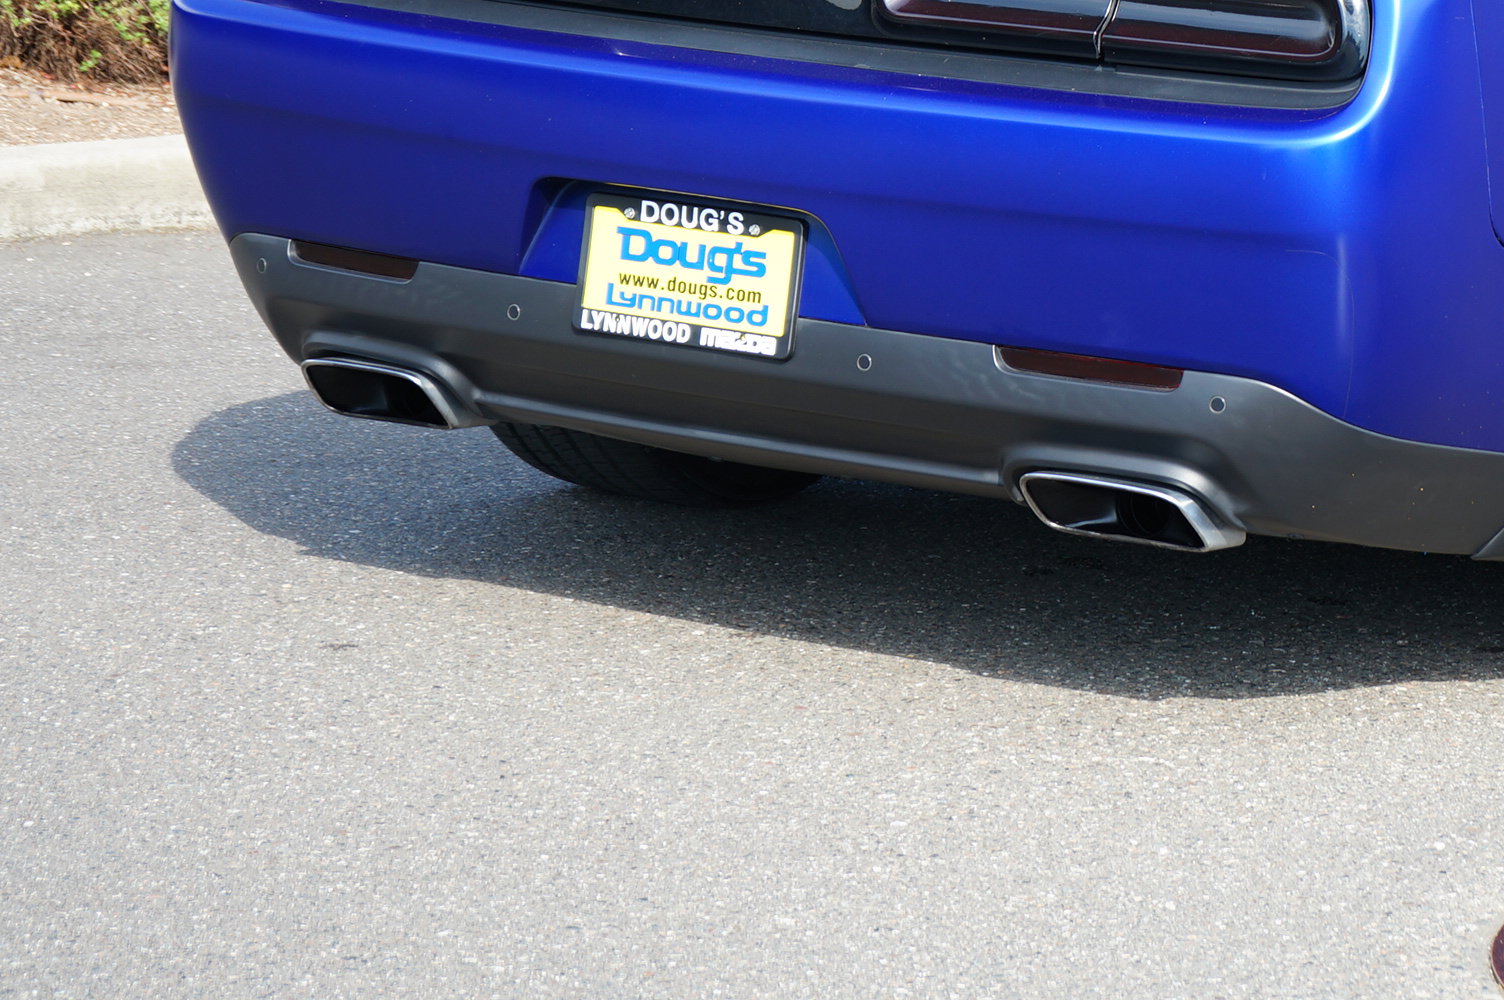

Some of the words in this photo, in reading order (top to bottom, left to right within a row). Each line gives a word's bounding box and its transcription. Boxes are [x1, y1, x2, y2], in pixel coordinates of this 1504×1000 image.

[640, 200, 745, 236] DOUG'S
[605, 282, 769, 327] Lynnwood
[618, 272, 763, 304] www.dougs.com
[580, 309, 691, 344] LYNNWOOD
